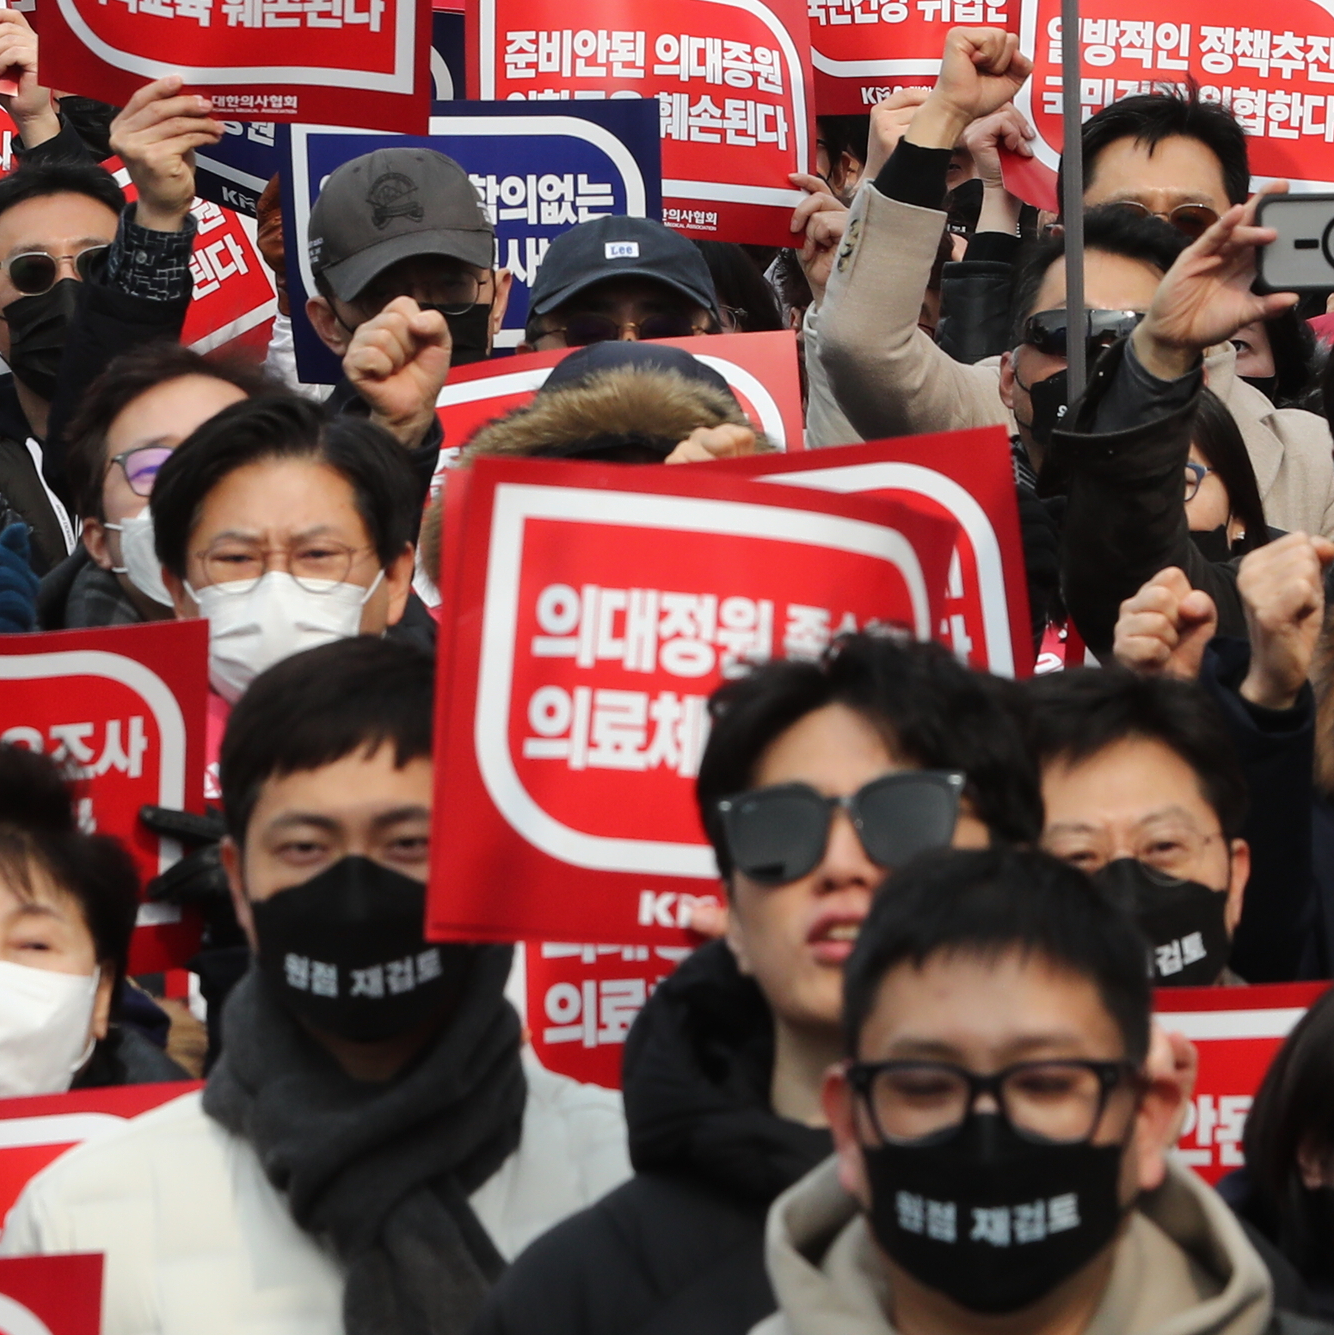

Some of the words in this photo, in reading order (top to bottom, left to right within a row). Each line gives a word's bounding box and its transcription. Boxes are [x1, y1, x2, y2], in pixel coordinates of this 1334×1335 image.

[503, 29, 645, 80] 준비안된
[654, 34, 783, 96] 의대증원
[212, 94, 297, 109] 대한의사협회
[609, 242, 635, 257] Lee
[531, 582, 775, 675] 의대정원
[283, 950, 340, 1000] 원점
[350, 946, 444, 1001] 재검토
[894, 1188, 957, 1245] 원점
[969, 1190, 1081, 1250] 재검토
